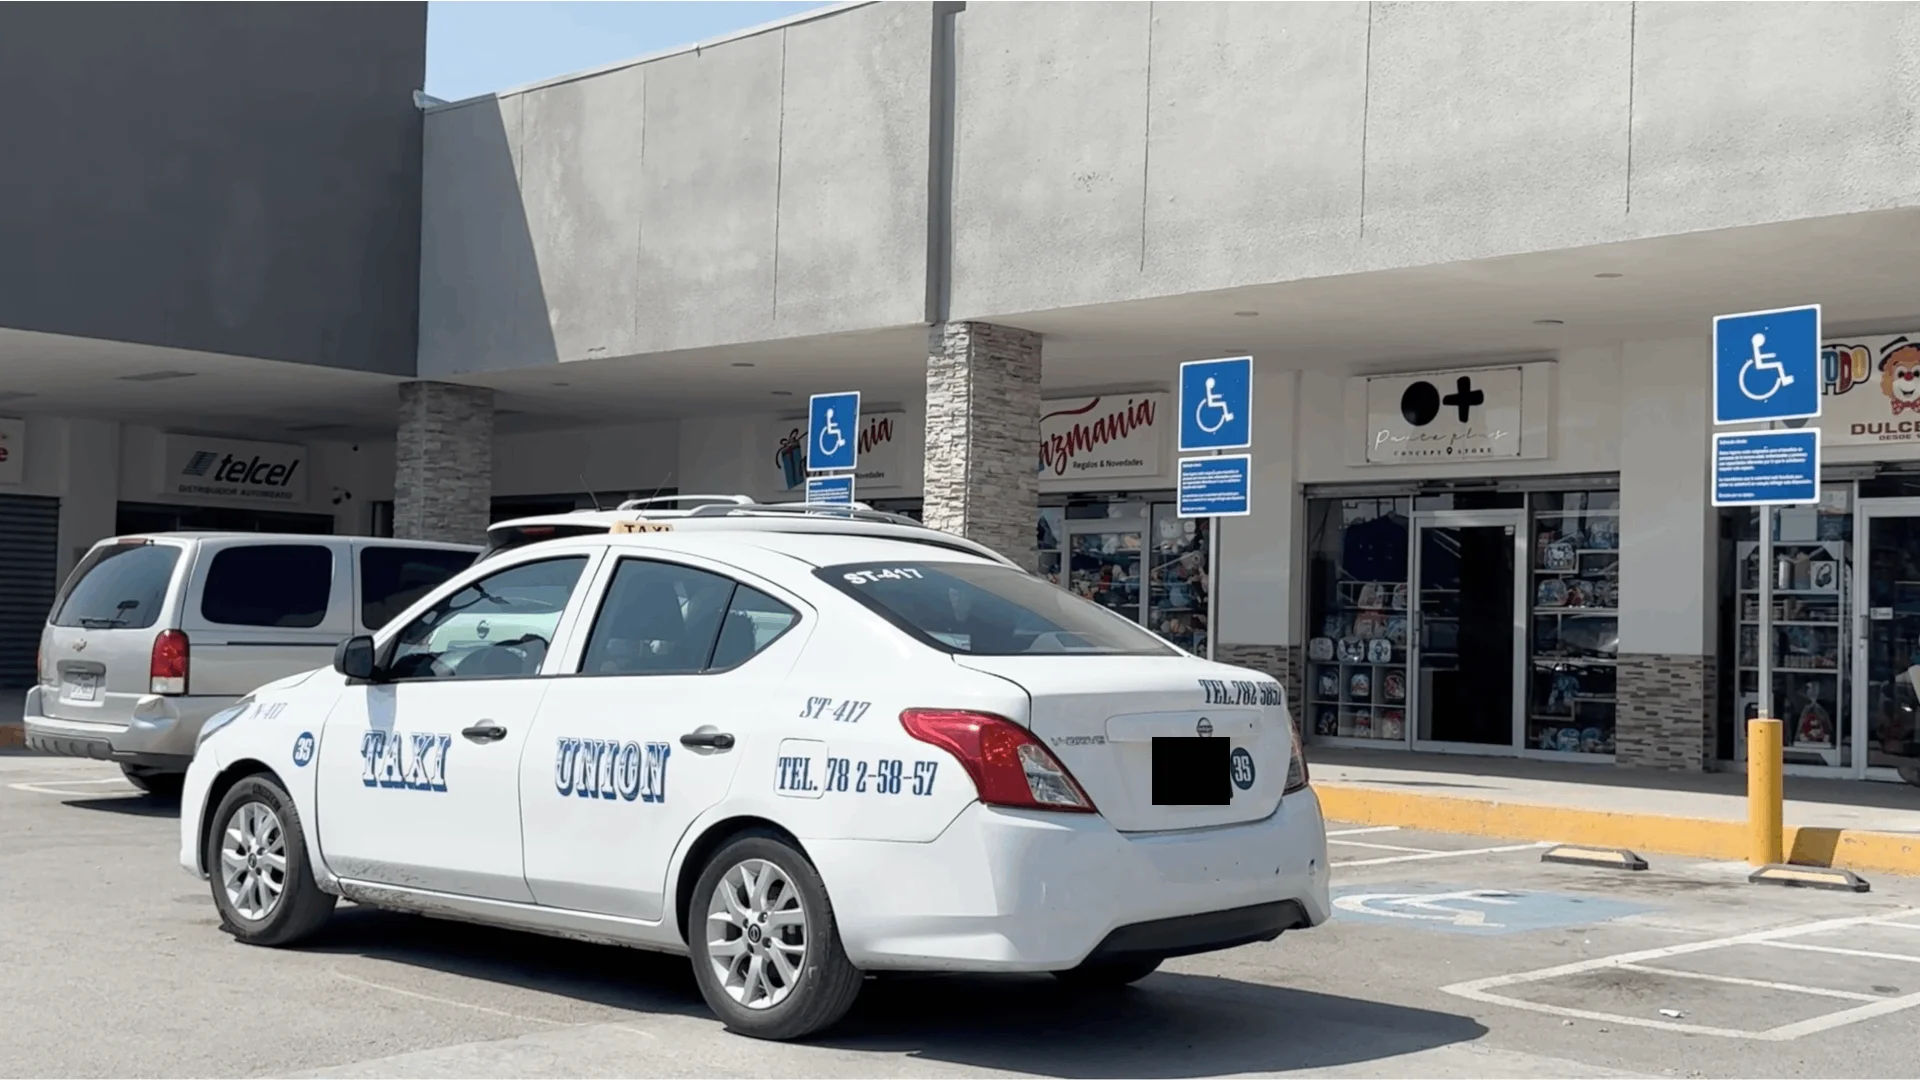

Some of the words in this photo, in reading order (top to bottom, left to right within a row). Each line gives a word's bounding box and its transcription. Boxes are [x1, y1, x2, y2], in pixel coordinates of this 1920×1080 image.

[1821, 344, 1872, 396] ODO
[1039, 398, 1156, 476] azmania
[1457, 447, 1492, 455] STORE
[1879, 433, 1912, 441] DESDE
[214, 453, 300, 487] telcel
[1073, 459, 1098, 470] Regalos
[1100, 459, 1105, 468] &
[1106, 458, 1144, 468] Novedades
[843, 567, 924, 585] ST-417
[799, 696, 872, 723] ST-417
[294, 737, 312, 762] 35
[360, 729, 452, 793] TAXI
[555, 736, 671, 804] UNION
[778, 756, 819, 792] TEL.
[1232, 755, 1252, 783] 35
